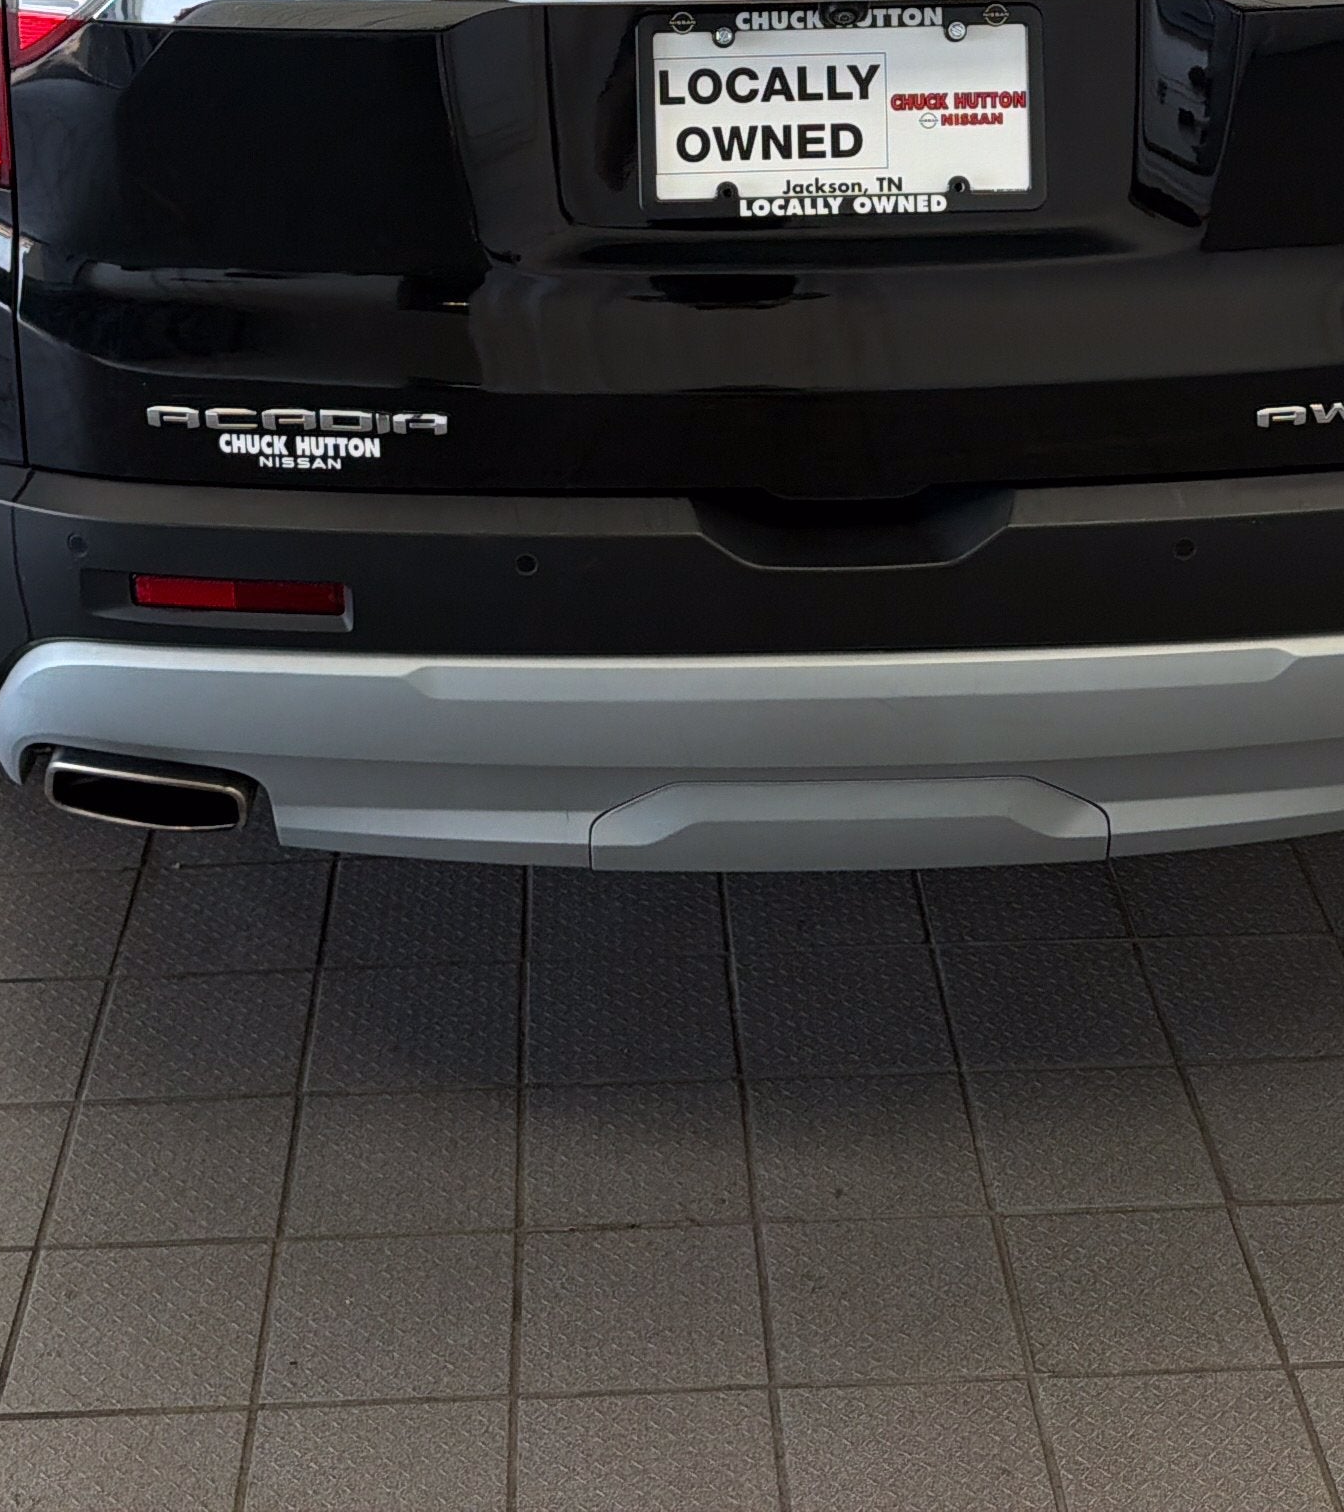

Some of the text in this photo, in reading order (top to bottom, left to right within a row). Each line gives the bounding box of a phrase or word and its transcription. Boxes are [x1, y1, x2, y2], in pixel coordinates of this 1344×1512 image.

[735, 6, 943, 31] CHUCK UTTON
[659, 64, 880, 106] LOCALLY
[890, 90, 1027, 111] CHUCK HUTTON
[940, 112, 1004, 127] NISSAN
[676, 122, 864, 163] OWNED
[782, 176, 903, 196] Jackson, TN
[739, 193, 948, 217] LOCALLY OWNED
[146, 405, 448, 436] ACADIA
[218, 433, 382, 459] CHUCK HUTTON
[258, 455, 342, 470] NISSAN
